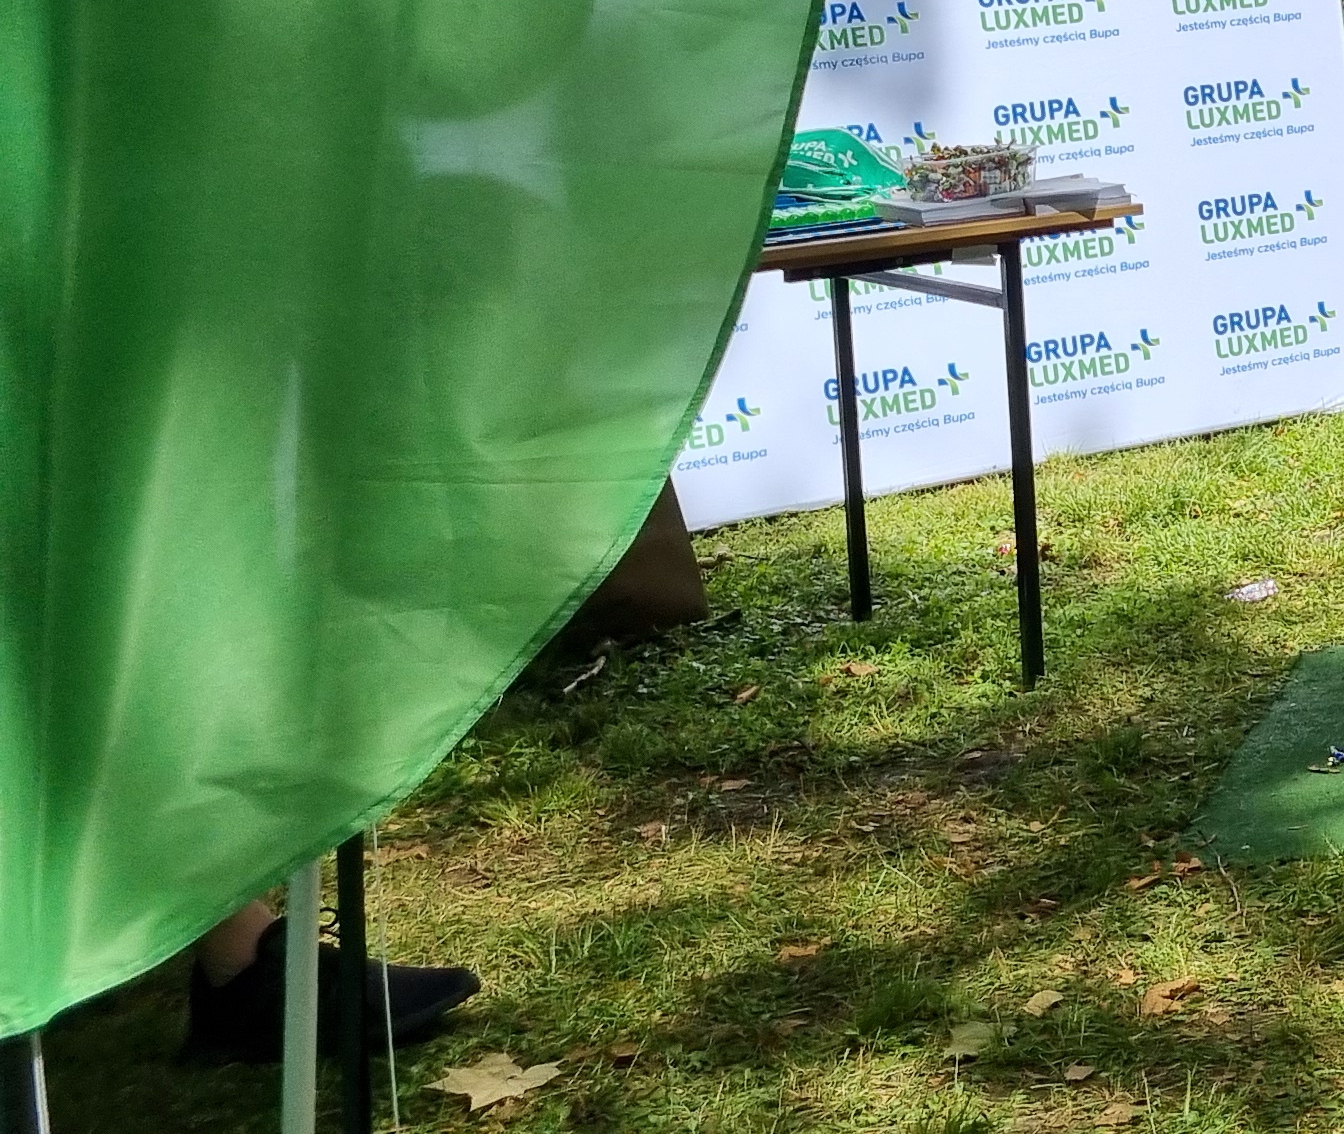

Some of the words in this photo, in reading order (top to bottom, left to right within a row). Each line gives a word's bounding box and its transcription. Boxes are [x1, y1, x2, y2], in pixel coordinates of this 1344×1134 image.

[981, 3, 1083, 31] LUXMED
[1175, 19, 1227, 33] Jesteśmy
[1273, 12, 1302, 23] Bupa
[985, 36, 1040, 50] Jesteśmy
[1089, 28, 1120, 40] Bupa
[891, 50, 925, 64] Bupa
[1184, 79, 1265, 106] GRUPA
[994, 97, 1081, 126] GRUPA
[1186, 100, 1281, 129] LUXMED
[1104, 144, 1135, 156] Bupa
[1190, 133, 1241, 148] Jesteśmy
[1286, 124, 1315, 135] Bupa
[1198, 191, 1278, 221] GRUPA
[1201, 213, 1294, 244] LUXMED
[1023, 236, 1114, 268] UXMED
[1204, 246, 1255, 262] Jesteśmy
[1299, 235, 1328, 247] Bupa
[1023, 271, 1072, 286] esteśmy
[1119, 260, 1150, 272] Bupa
[1213, 304, 1292, 335] GRUPA
[1025, 331, 1112, 364] GRUPA
[1215, 325, 1307, 358] LUXMED
[1030, 353, 1129, 387] LUXMED
[1219, 360, 1269, 377] Jesteśmy
[1313, 346, 1341, 359] Bupa
[824, 366, 917, 401] GUPA
[1033, 388, 1088, 406] Jesteśmy
[1135, 376, 1165, 388] Bupa
[827, 388, 937, 426] LXMED
[943, 411, 976, 425] Bupa
[732, 448, 768, 463] Bupa
